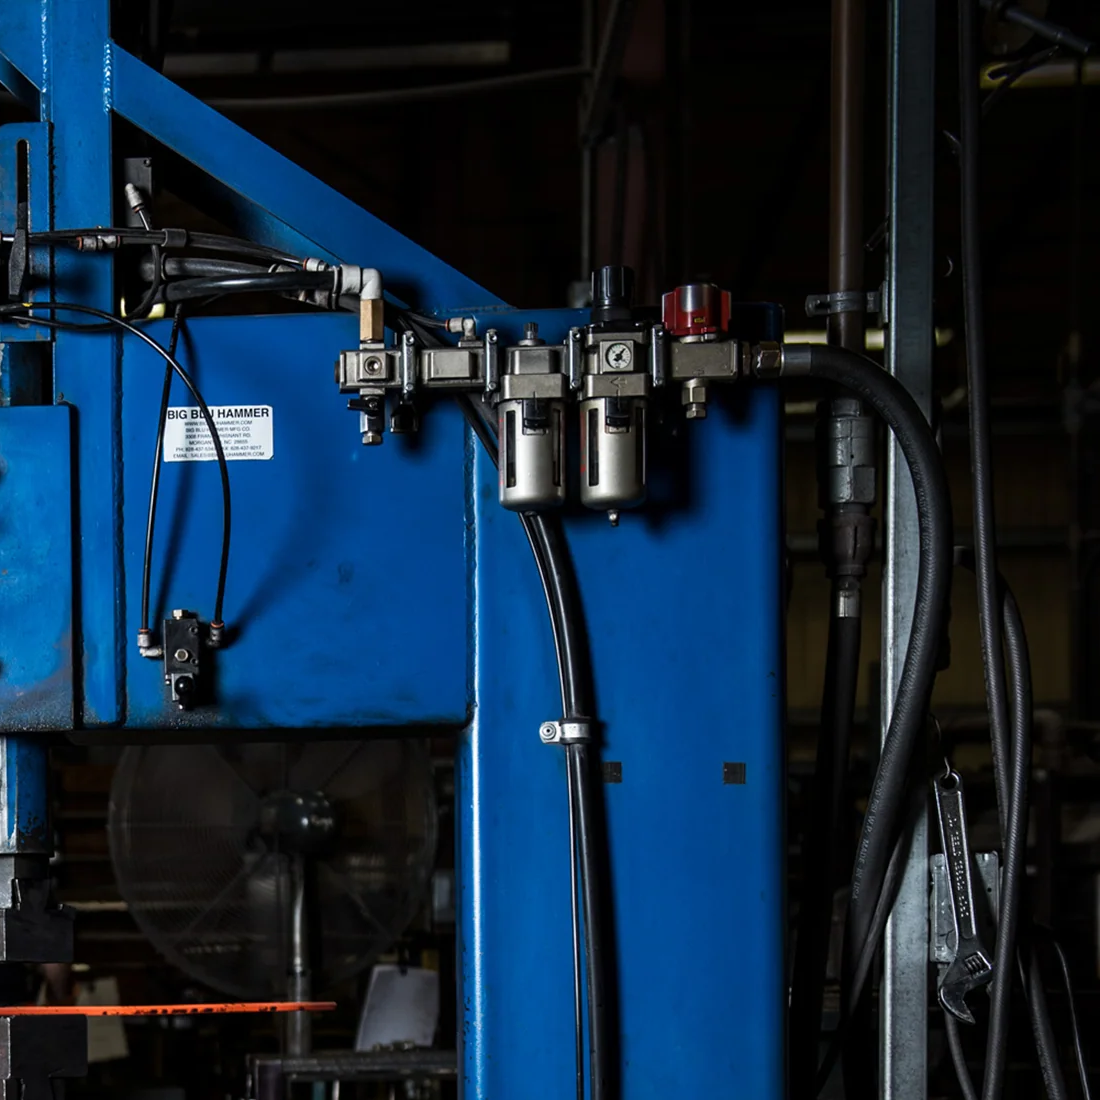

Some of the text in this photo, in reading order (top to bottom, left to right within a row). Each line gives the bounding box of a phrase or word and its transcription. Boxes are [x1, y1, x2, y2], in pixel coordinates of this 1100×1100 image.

[167, 410, 188, 420] BIG
[217, 408, 270, 418] HAMMER
[860, 839, 870, 865] MADE
